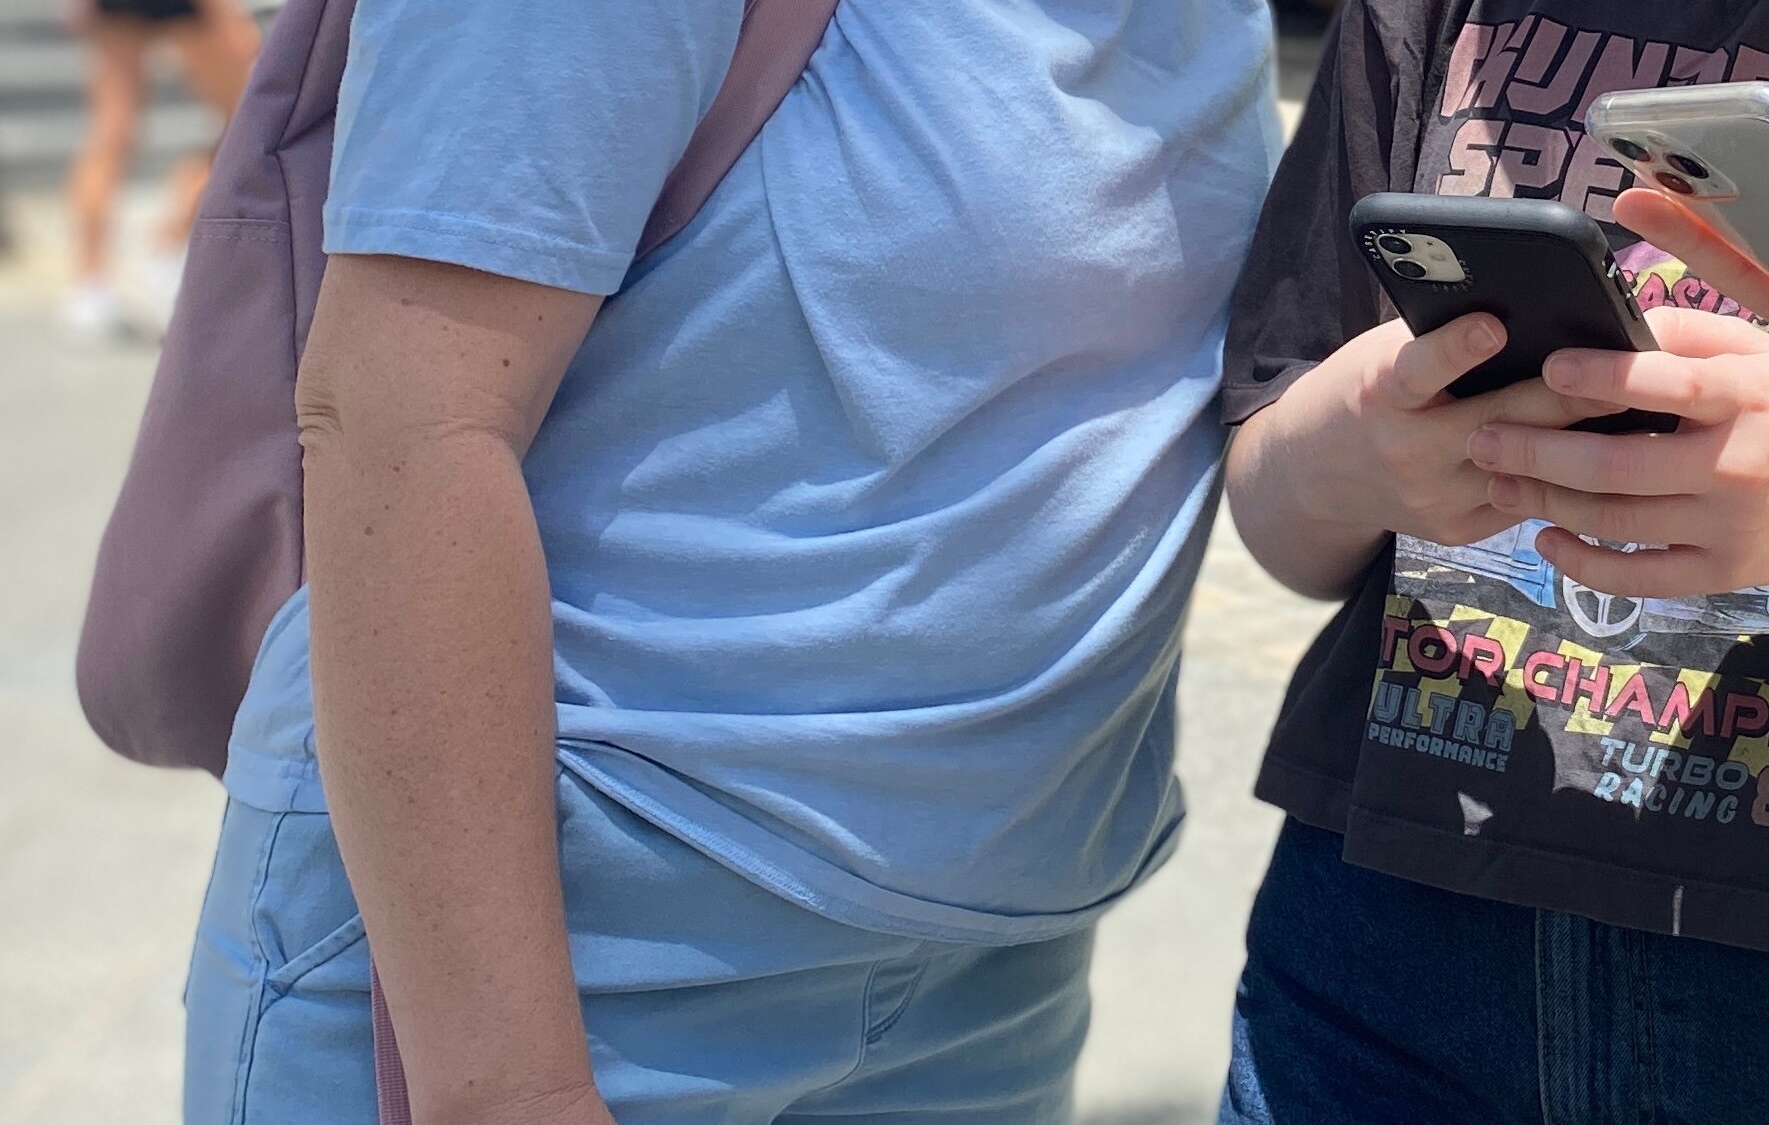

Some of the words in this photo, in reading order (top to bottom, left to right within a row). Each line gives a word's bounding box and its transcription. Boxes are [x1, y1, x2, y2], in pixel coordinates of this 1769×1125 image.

[1373, 681, 1517, 753] ULTRA
[1367, 722, 1510, 773] PERFORMANCE
[1600, 735, 1750, 791] TURBO
[1593, 771, 1740, 824] RACING
